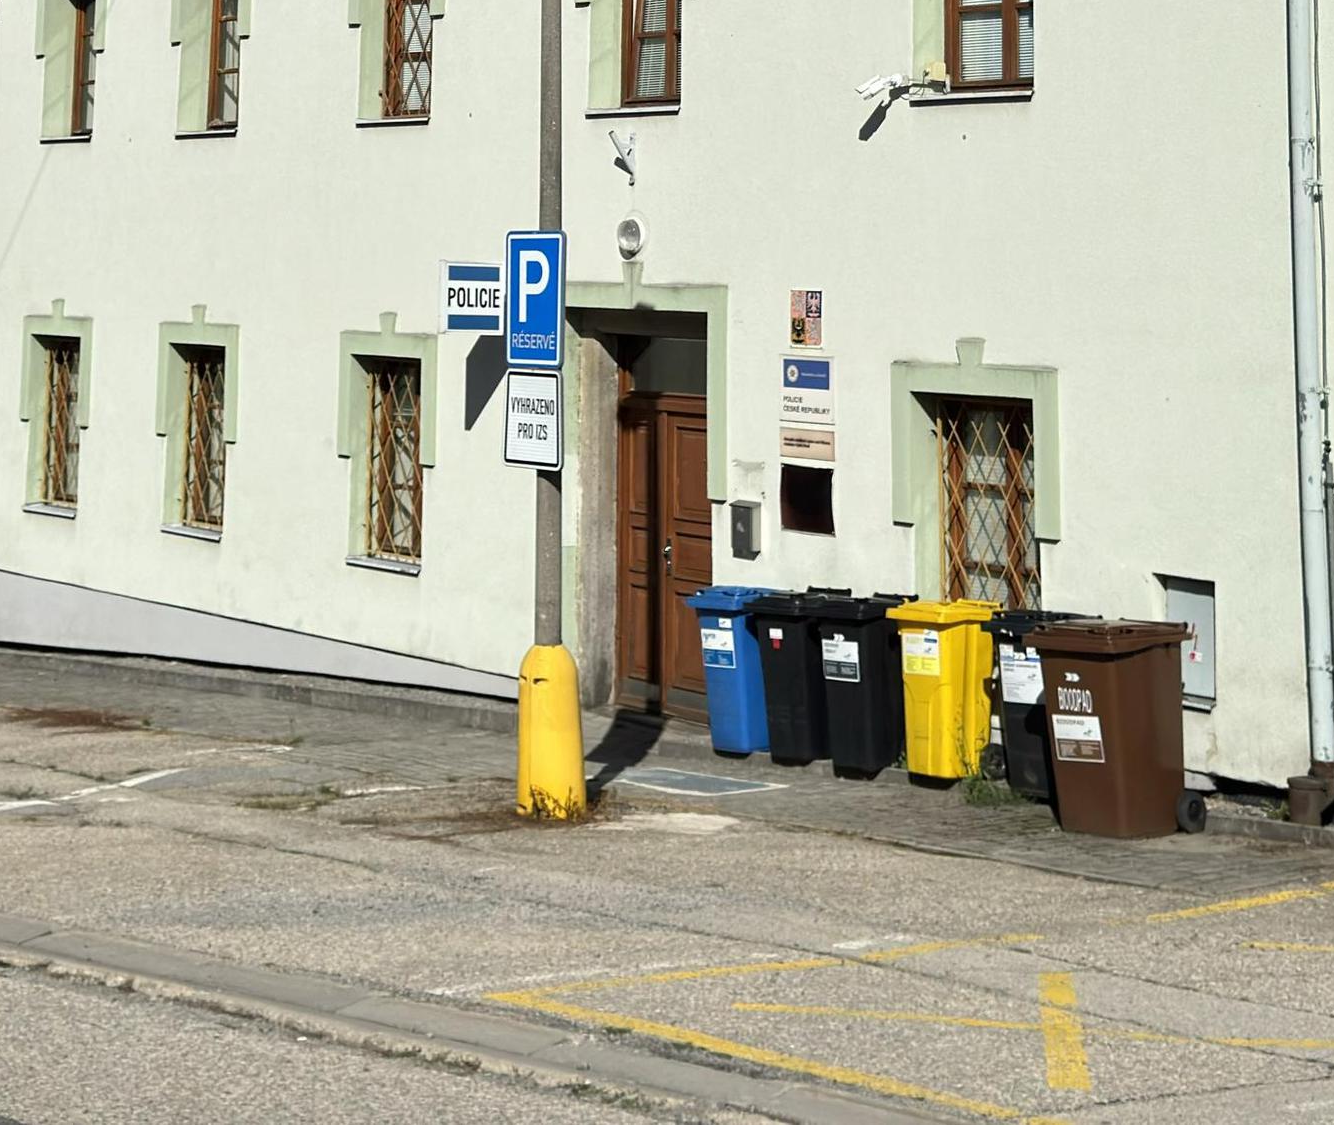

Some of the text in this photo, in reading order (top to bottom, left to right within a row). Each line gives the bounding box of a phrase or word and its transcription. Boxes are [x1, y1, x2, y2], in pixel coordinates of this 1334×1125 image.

[518, 250, 551, 323] P
[447, 287, 500, 308] POLICIE
[511, 330, 556, 351] RÉSERVÉ
[511, 396, 555, 416] VYHRAZENO
[783, 395, 803, 403] POLICIE
[783, 404, 830, 414] ČESKÉ REPUBLIKY
[517, 422, 548, 441] PRO IZS
